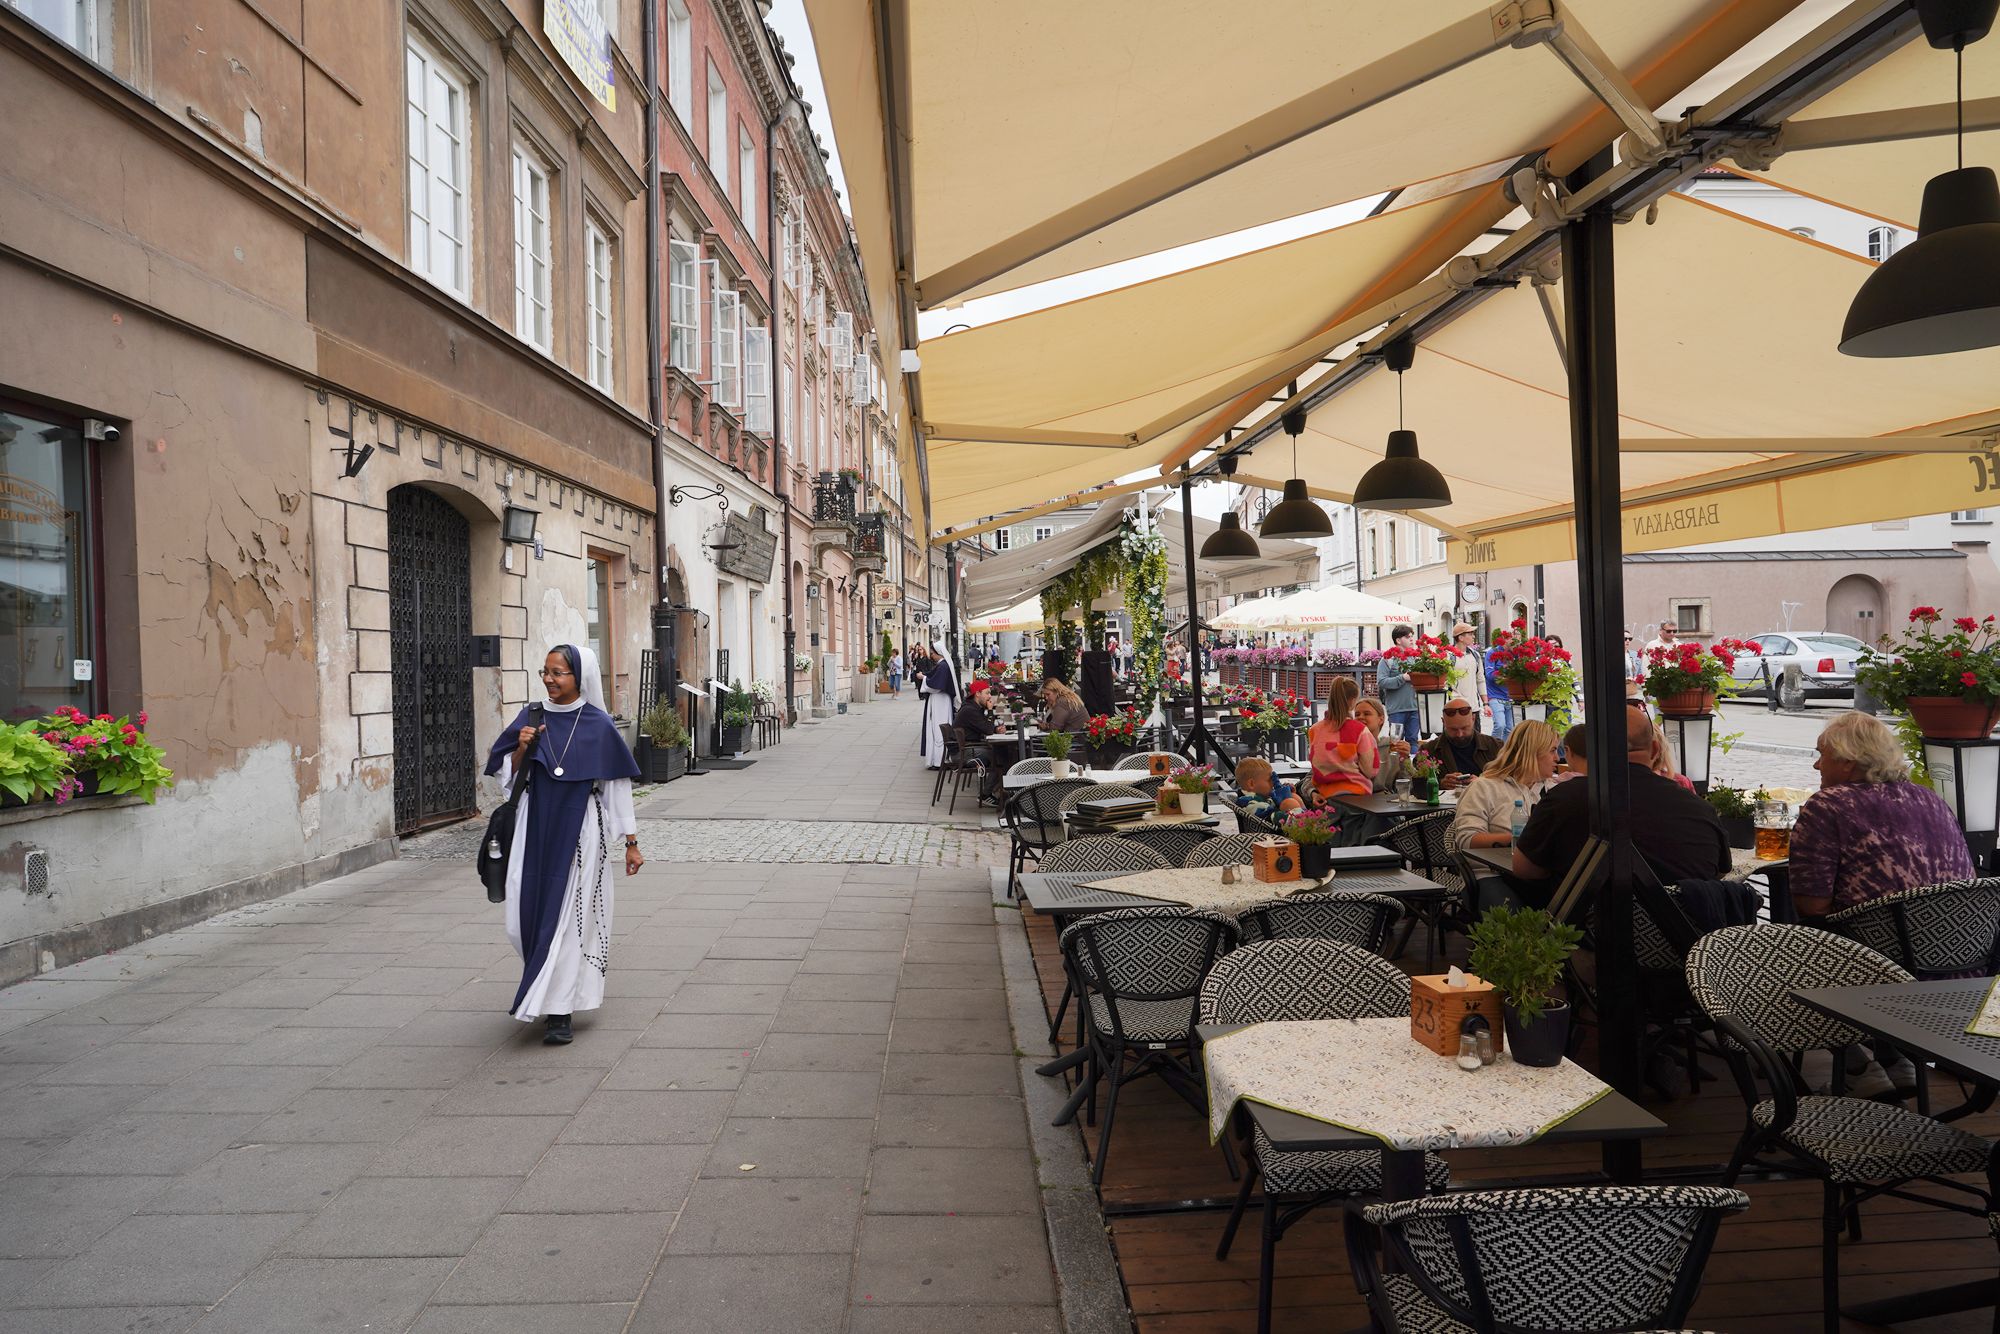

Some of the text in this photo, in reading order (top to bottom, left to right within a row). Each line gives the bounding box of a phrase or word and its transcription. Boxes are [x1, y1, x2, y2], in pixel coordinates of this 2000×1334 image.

[1300, 615, 1328, 623] TYSKIE
[1384, 615, 1412, 623] TYSKIE
[1414, 994, 1436, 1034] 23
